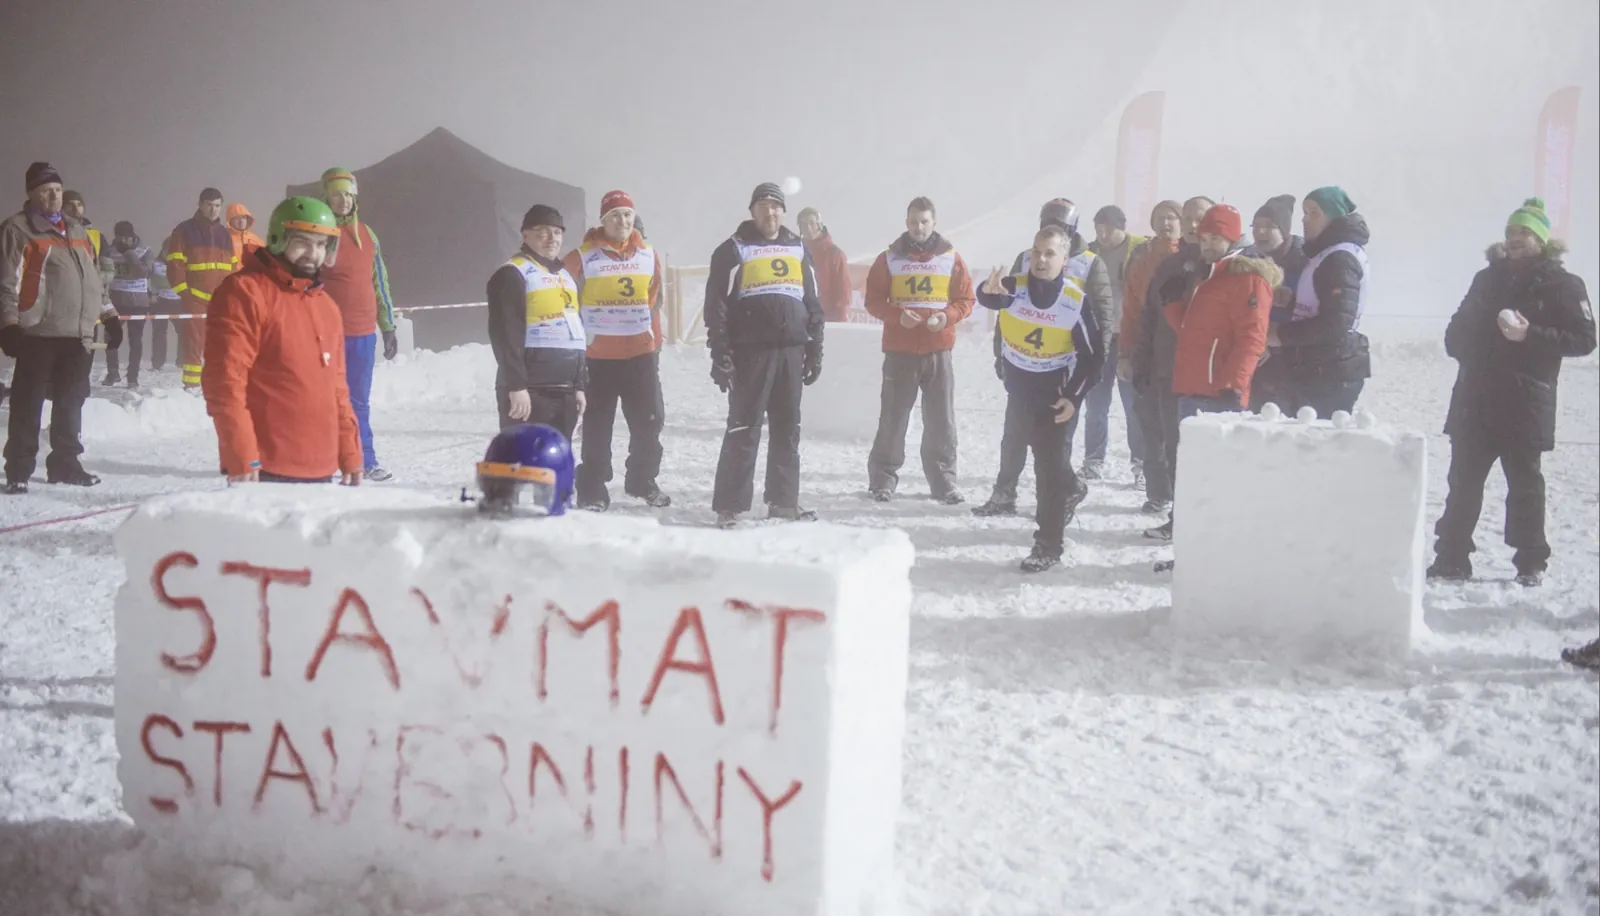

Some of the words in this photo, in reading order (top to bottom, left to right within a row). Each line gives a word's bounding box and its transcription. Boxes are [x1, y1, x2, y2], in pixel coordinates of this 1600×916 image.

[600, 263, 640, 273] STAVMAT
[770, 258, 789, 278] 9
[617, 276, 635, 298] 3
[904, 275, 933, 296] 14
[1023, 327, 1045, 350] 4
[150, 550, 827, 738] STAVMAT
